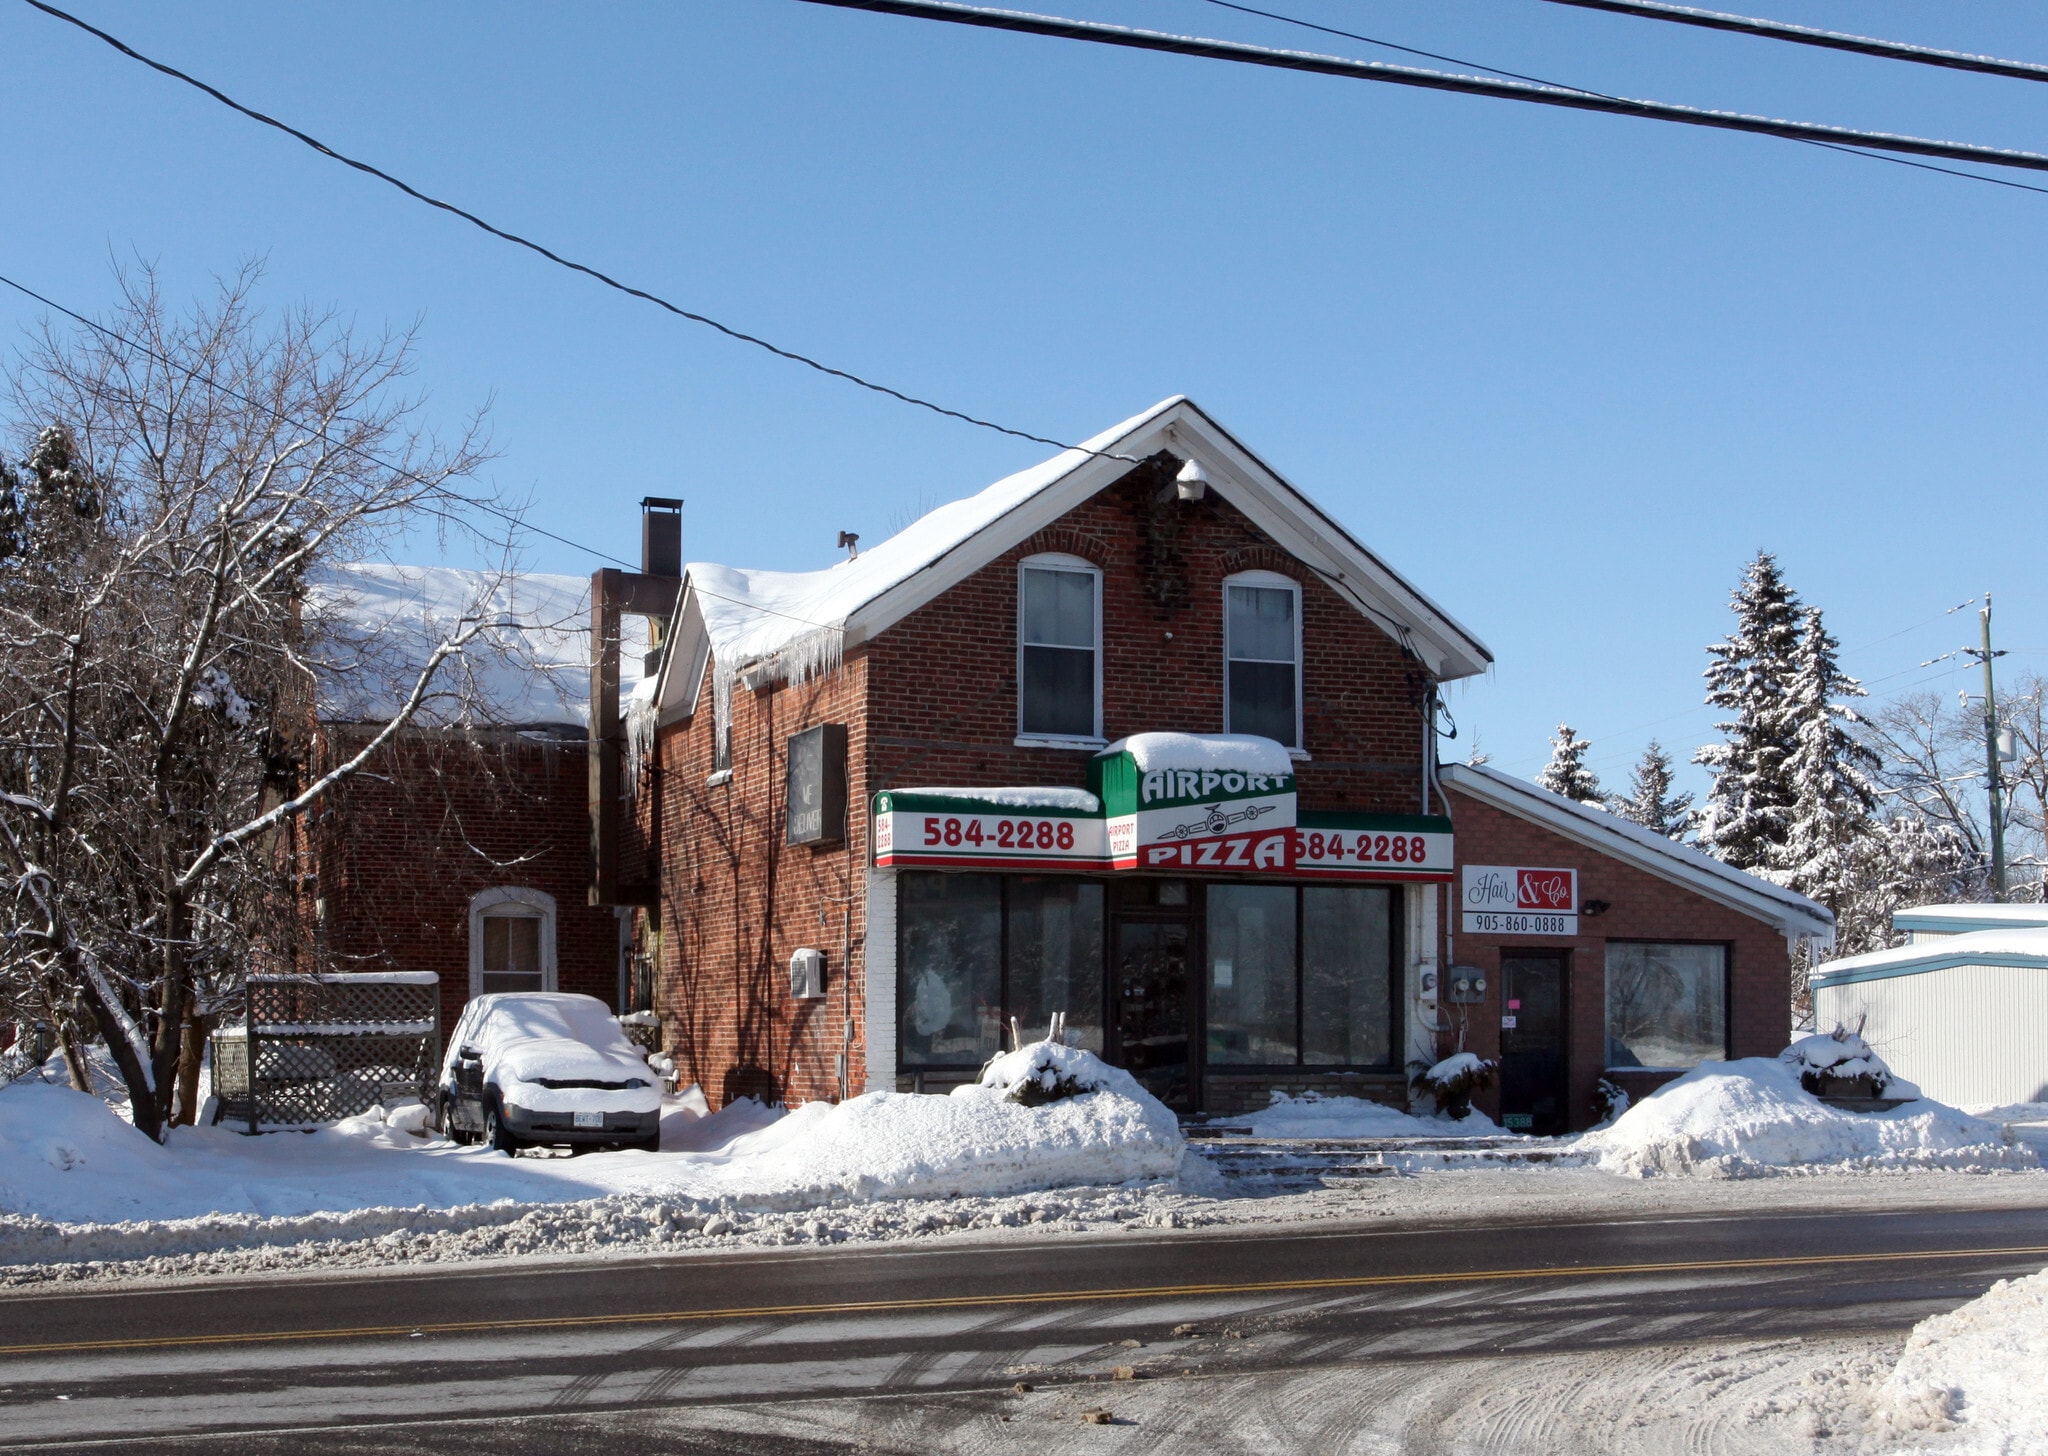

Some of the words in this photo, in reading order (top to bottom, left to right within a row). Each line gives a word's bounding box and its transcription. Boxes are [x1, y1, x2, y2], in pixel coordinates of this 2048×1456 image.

[1142, 769, 1289, 804] AIRPORT
[924, 817, 1075, 850] 584-2288
[1108, 822, 1134, 837] AIRPORT
[1113, 840, 1130, 852] PIZZA
[1148, 834, 1286, 870] PIZZA
[1296, 832, 1426, 863] 584-2288
[1468, 873, 1516, 904] Hair
[1518, 873, 1540, 904] &
[1541, 876, 1569, 907] Co.
[1476, 915, 1565, 932] 905-860-0888
[1503, 1116, 1533, 1128] 15388
